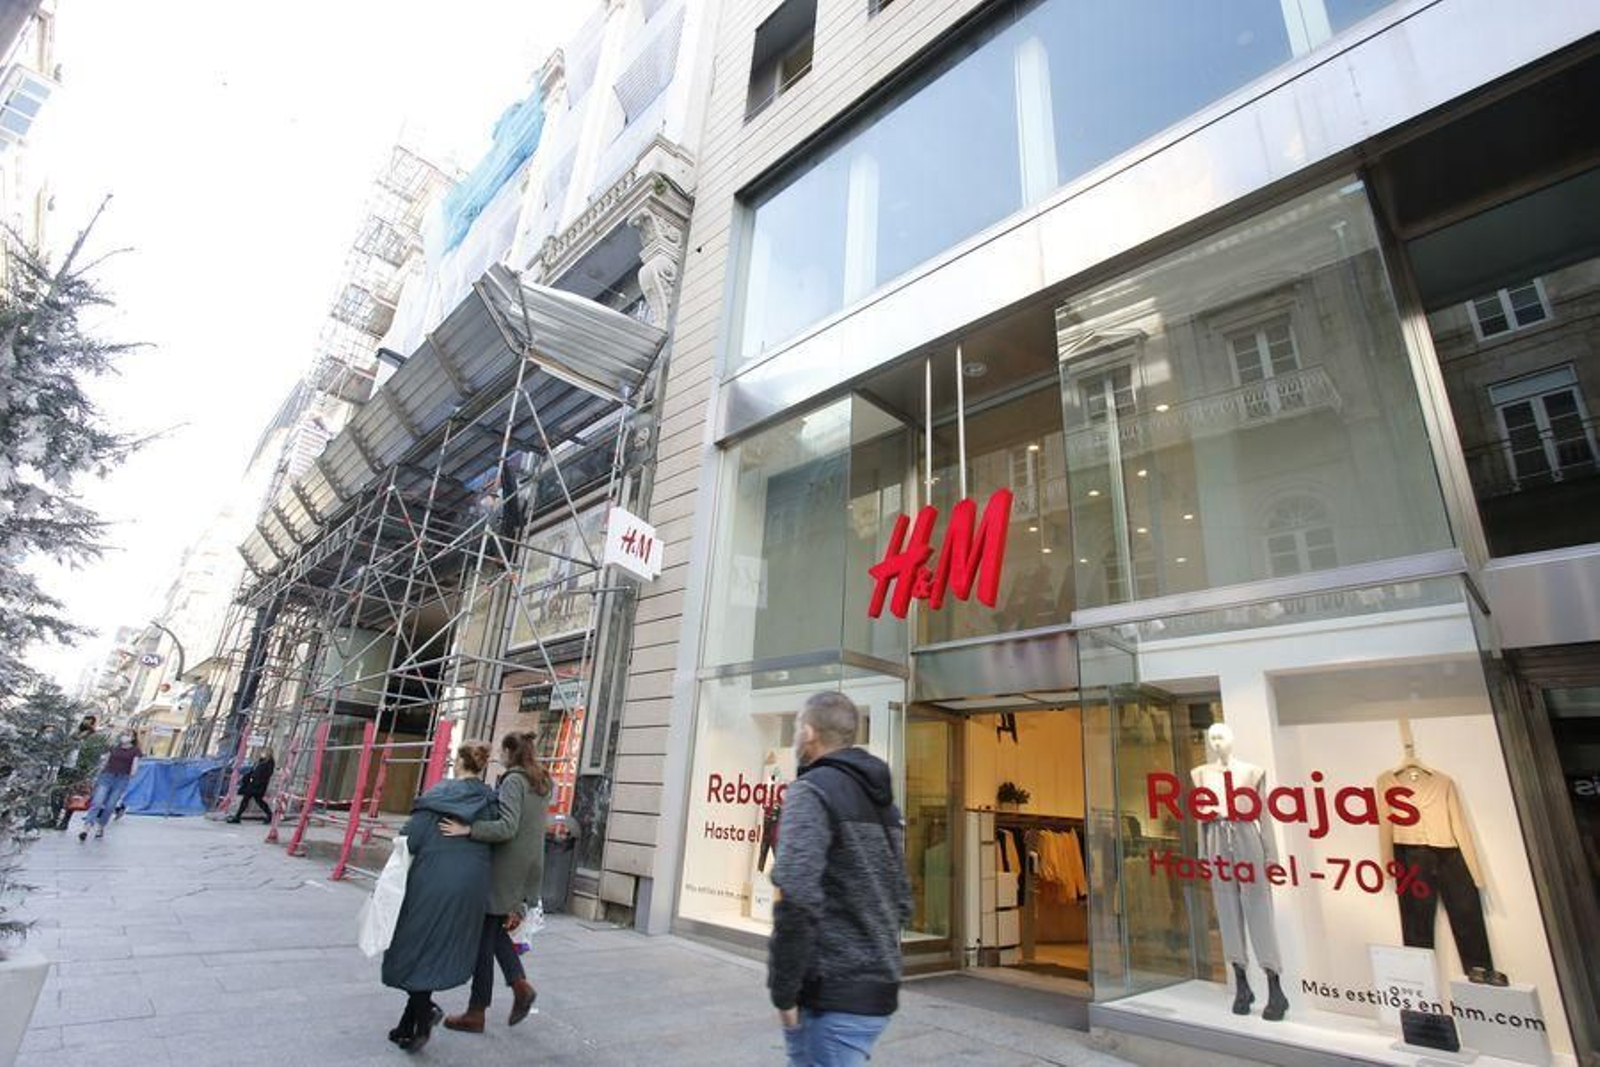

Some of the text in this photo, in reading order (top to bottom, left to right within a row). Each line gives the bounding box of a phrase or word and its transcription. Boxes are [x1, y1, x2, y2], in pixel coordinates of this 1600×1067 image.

[621, 526, 653, 564] H&M
[868, 487, 1014, 619] H&M
[706, 773, 789, 818] Rebaj
[1145, 771, 1421, 839] Rebajas
[704, 821, 761, 843] Hasta el
[1149, 847, 1431, 899] Hasta el -70%
[1301, 979, 1546, 1032] Más estilos en hm.com
